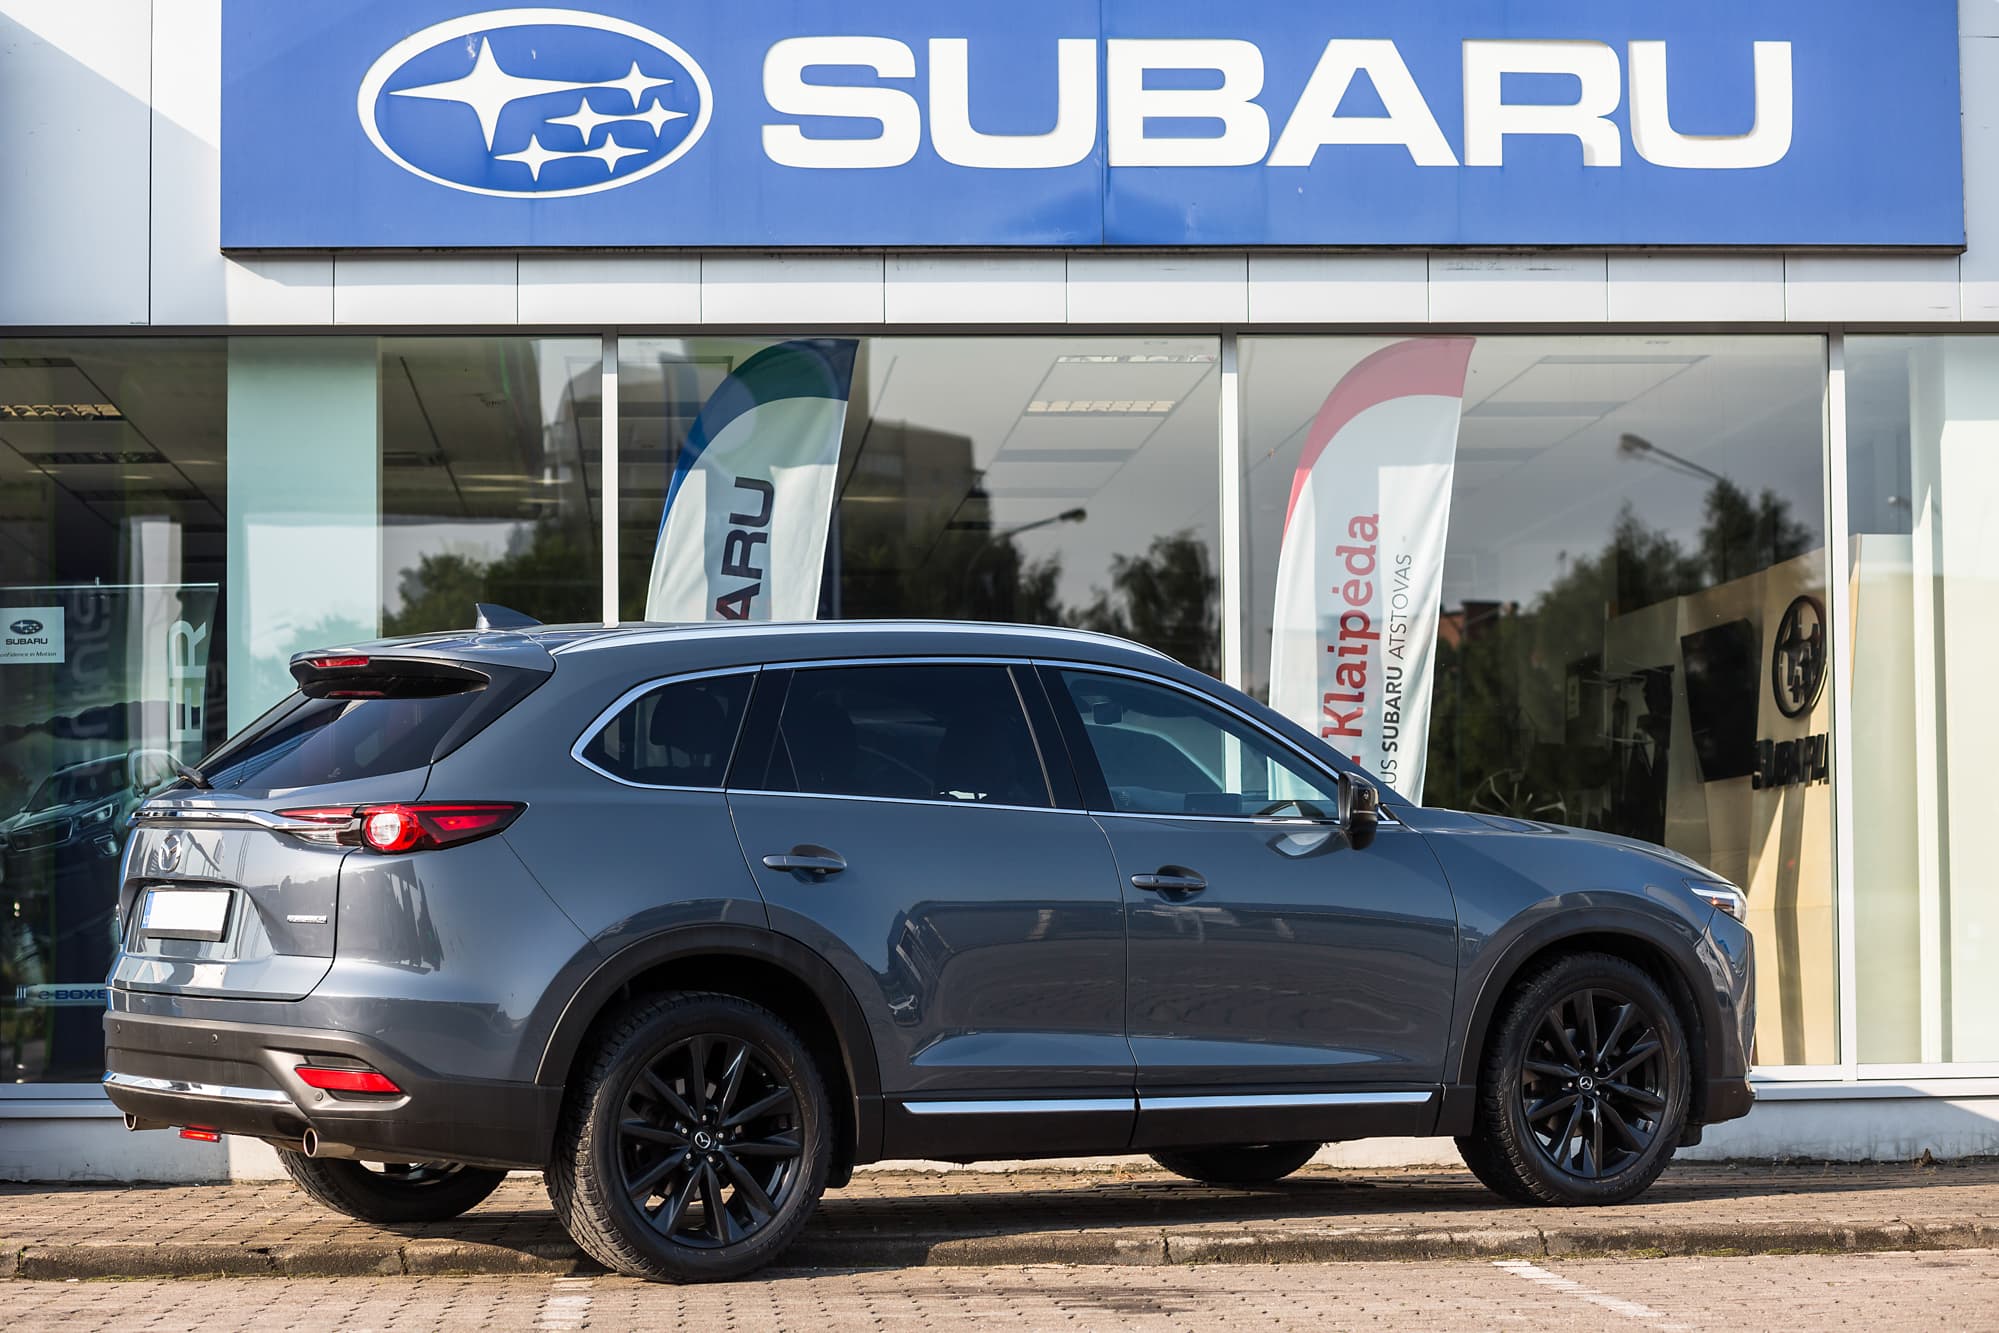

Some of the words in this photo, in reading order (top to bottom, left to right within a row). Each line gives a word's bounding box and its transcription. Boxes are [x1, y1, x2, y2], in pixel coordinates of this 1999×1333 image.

[762, 35, 1793, 169] SUBARU
[5, 637, 48, 645] SUBARU
[1321, 513, 1381, 738] Klaipėda
[1388, 554, 1412, 660] ATSTOVAS
[1381, 666, 1403, 752] SUBARU
[1380, 759, 1398, 792] US
